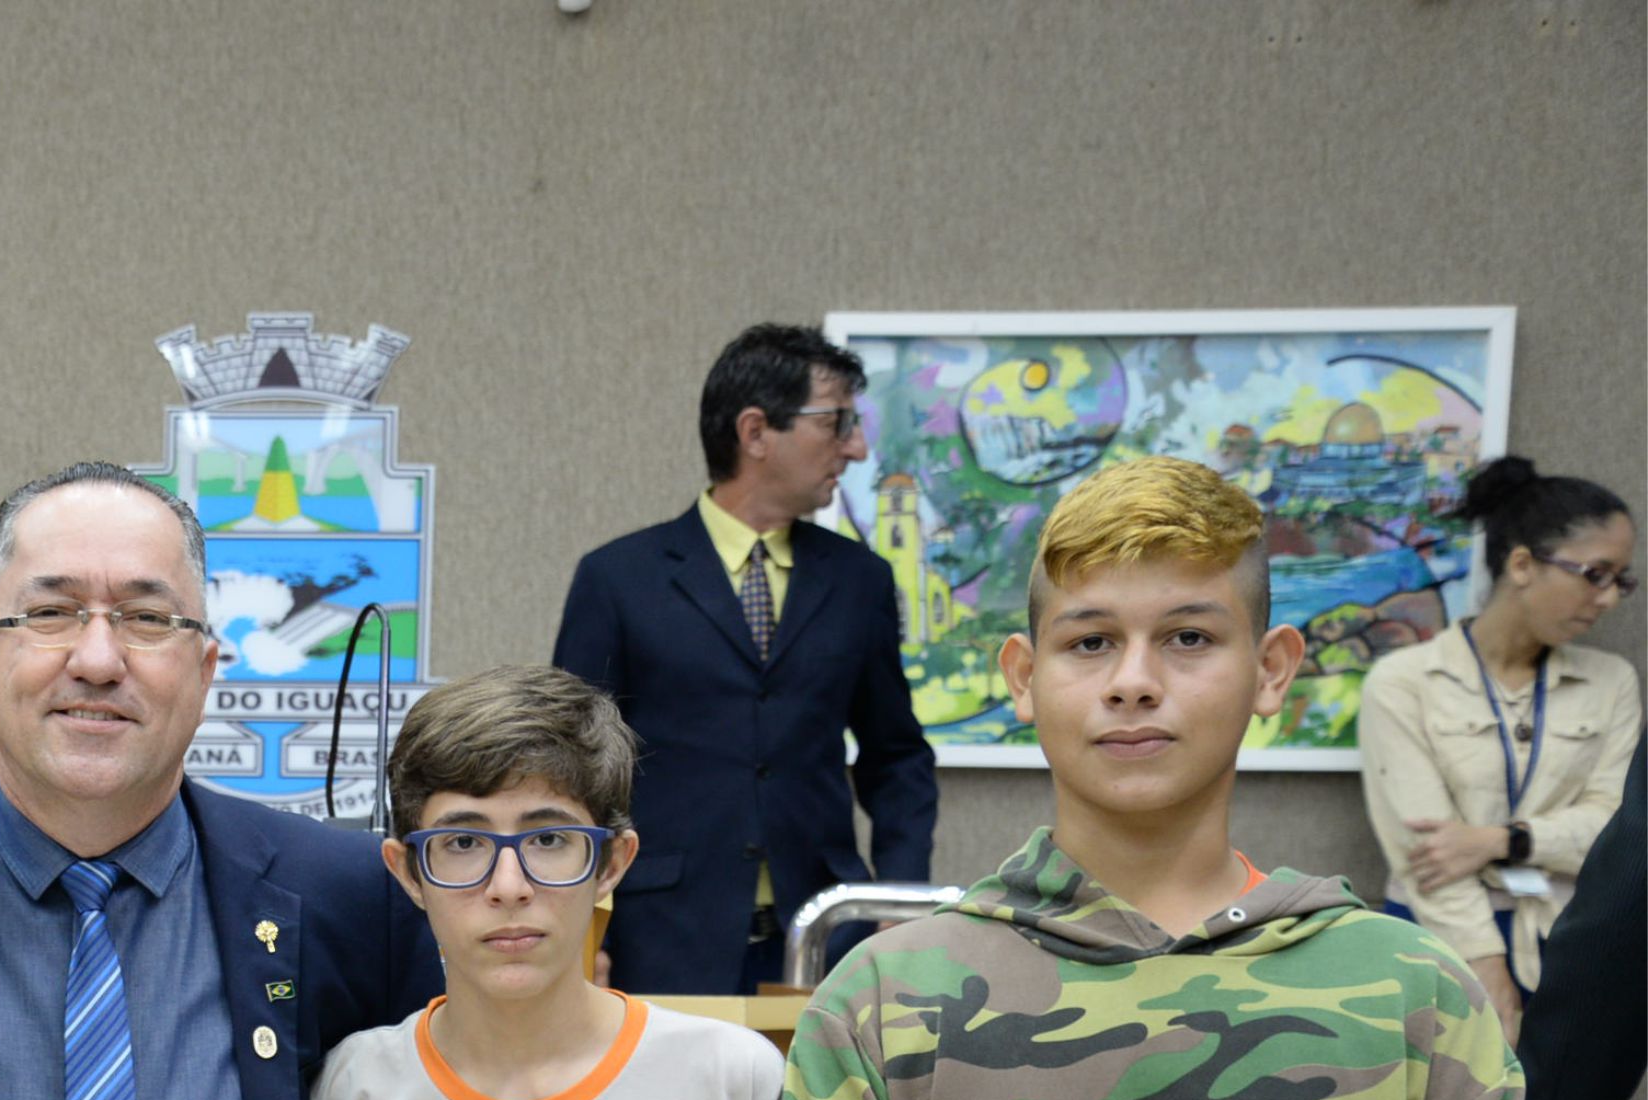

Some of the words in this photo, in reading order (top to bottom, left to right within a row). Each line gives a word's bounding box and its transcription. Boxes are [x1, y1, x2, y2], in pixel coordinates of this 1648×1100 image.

[217, 691, 261, 710] DO
[276, 691, 407, 719] IGUAÇU
[188, 743, 242, 765] ANÁ
[313, 750, 379, 766] BRAS
